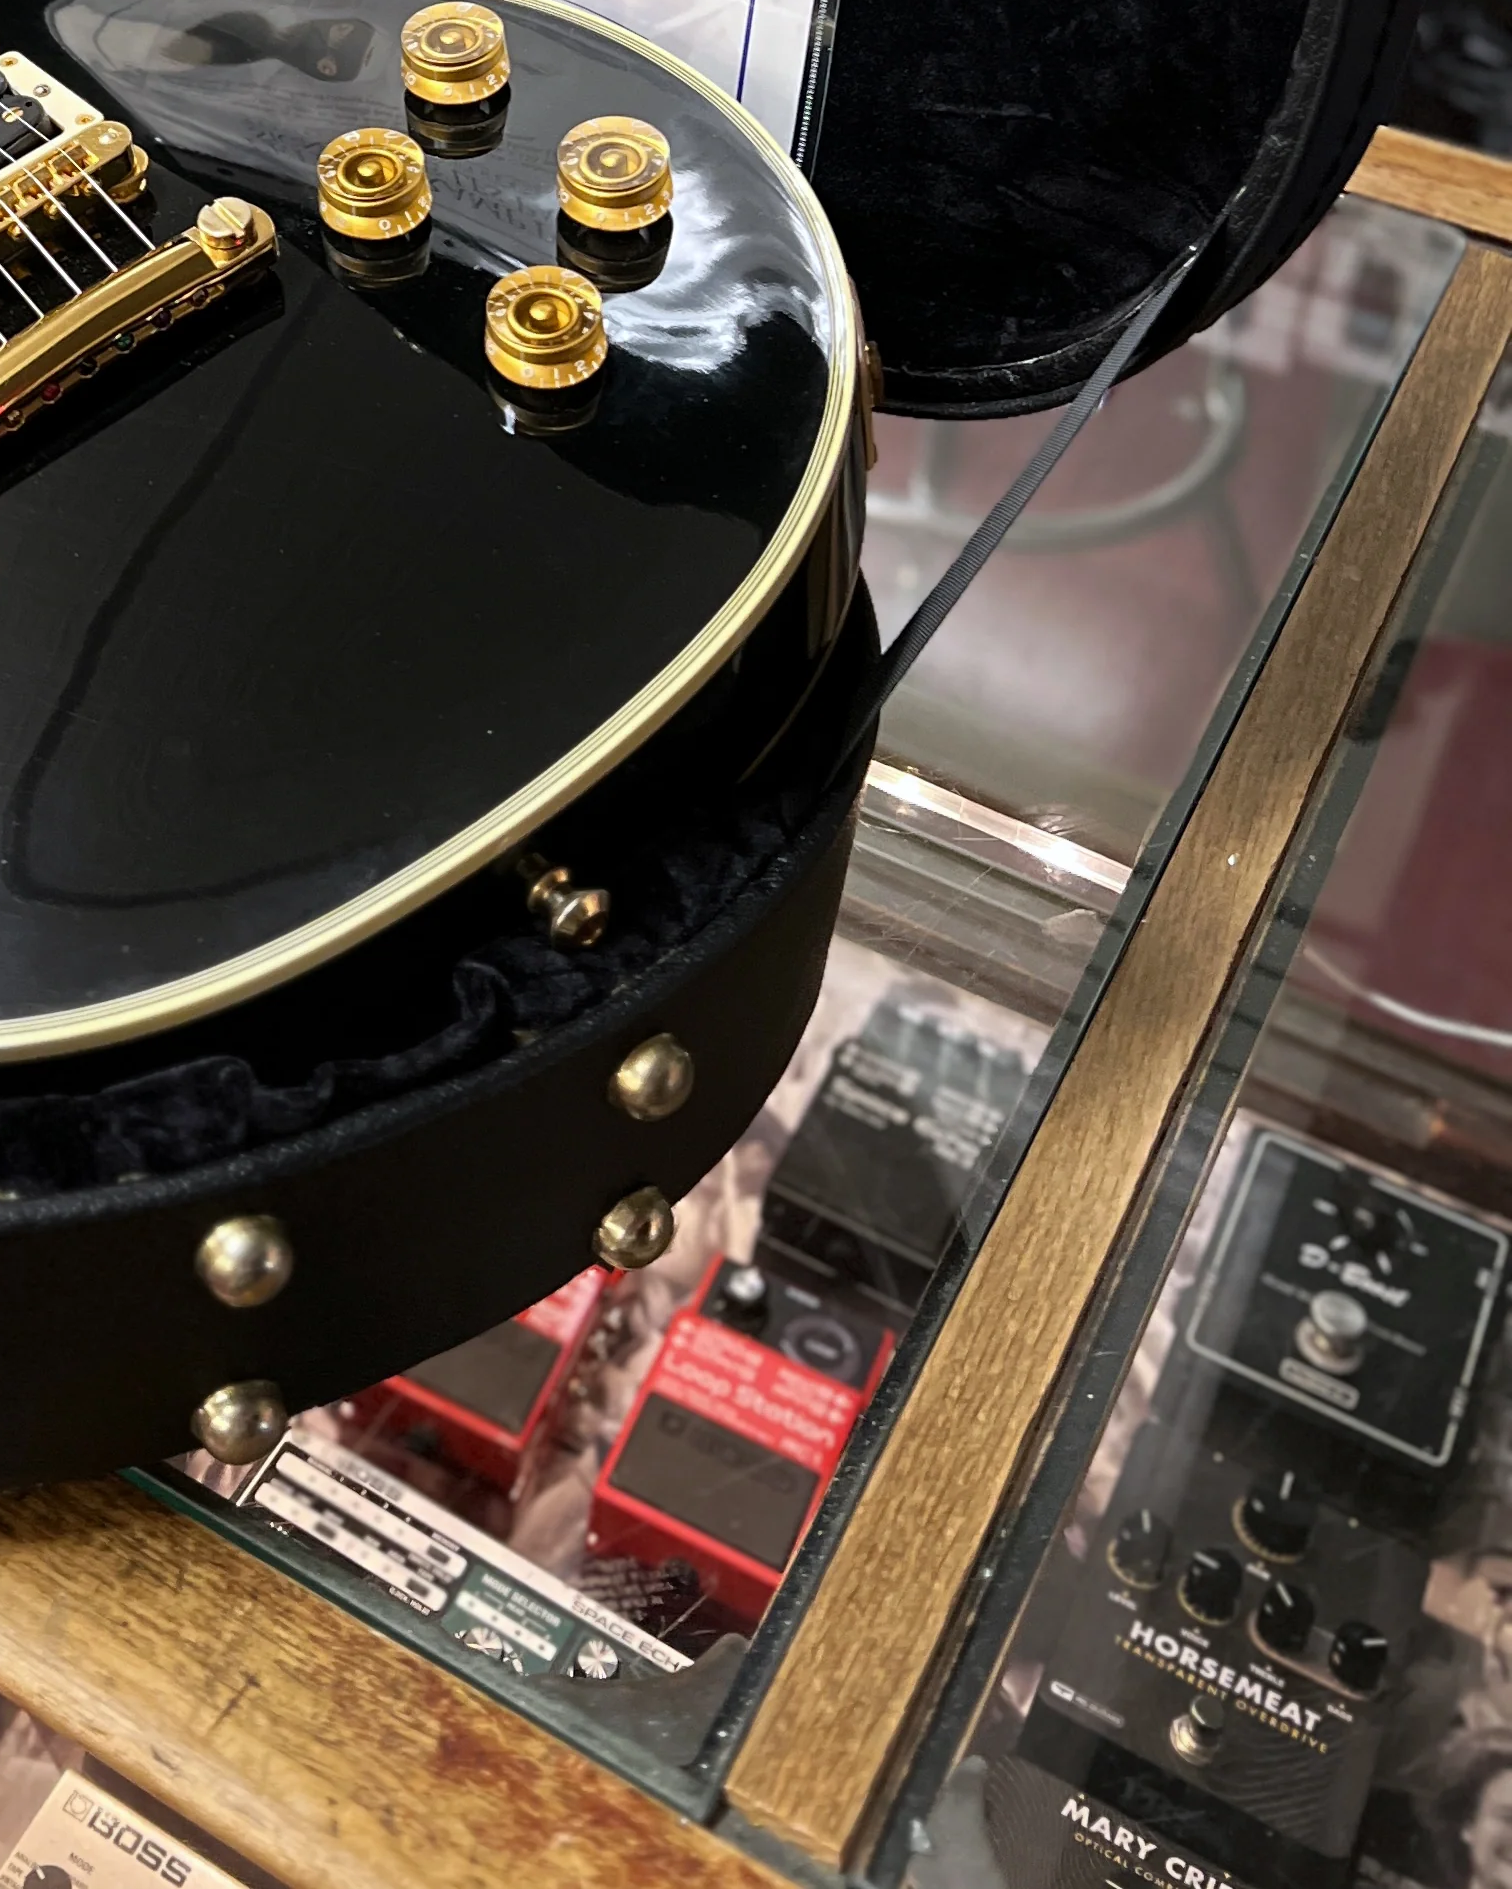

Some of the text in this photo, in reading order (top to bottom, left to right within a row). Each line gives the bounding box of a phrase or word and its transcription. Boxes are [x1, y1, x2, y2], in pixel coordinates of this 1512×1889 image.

[735, 1383, 836, 1450] Station
[571, 1598, 634, 1644] SPACE
[1115, 1634, 1329, 1754] TRANSPARENT OVERDRIVE
[1129, 1620, 1322, 1732] HORSEMEAT
[87, 1806, 192, 1888] BOSS
[1061, 1798, 1157, 1861] MARY
[1074, 1832, 1129, 1869] OPTICAL
